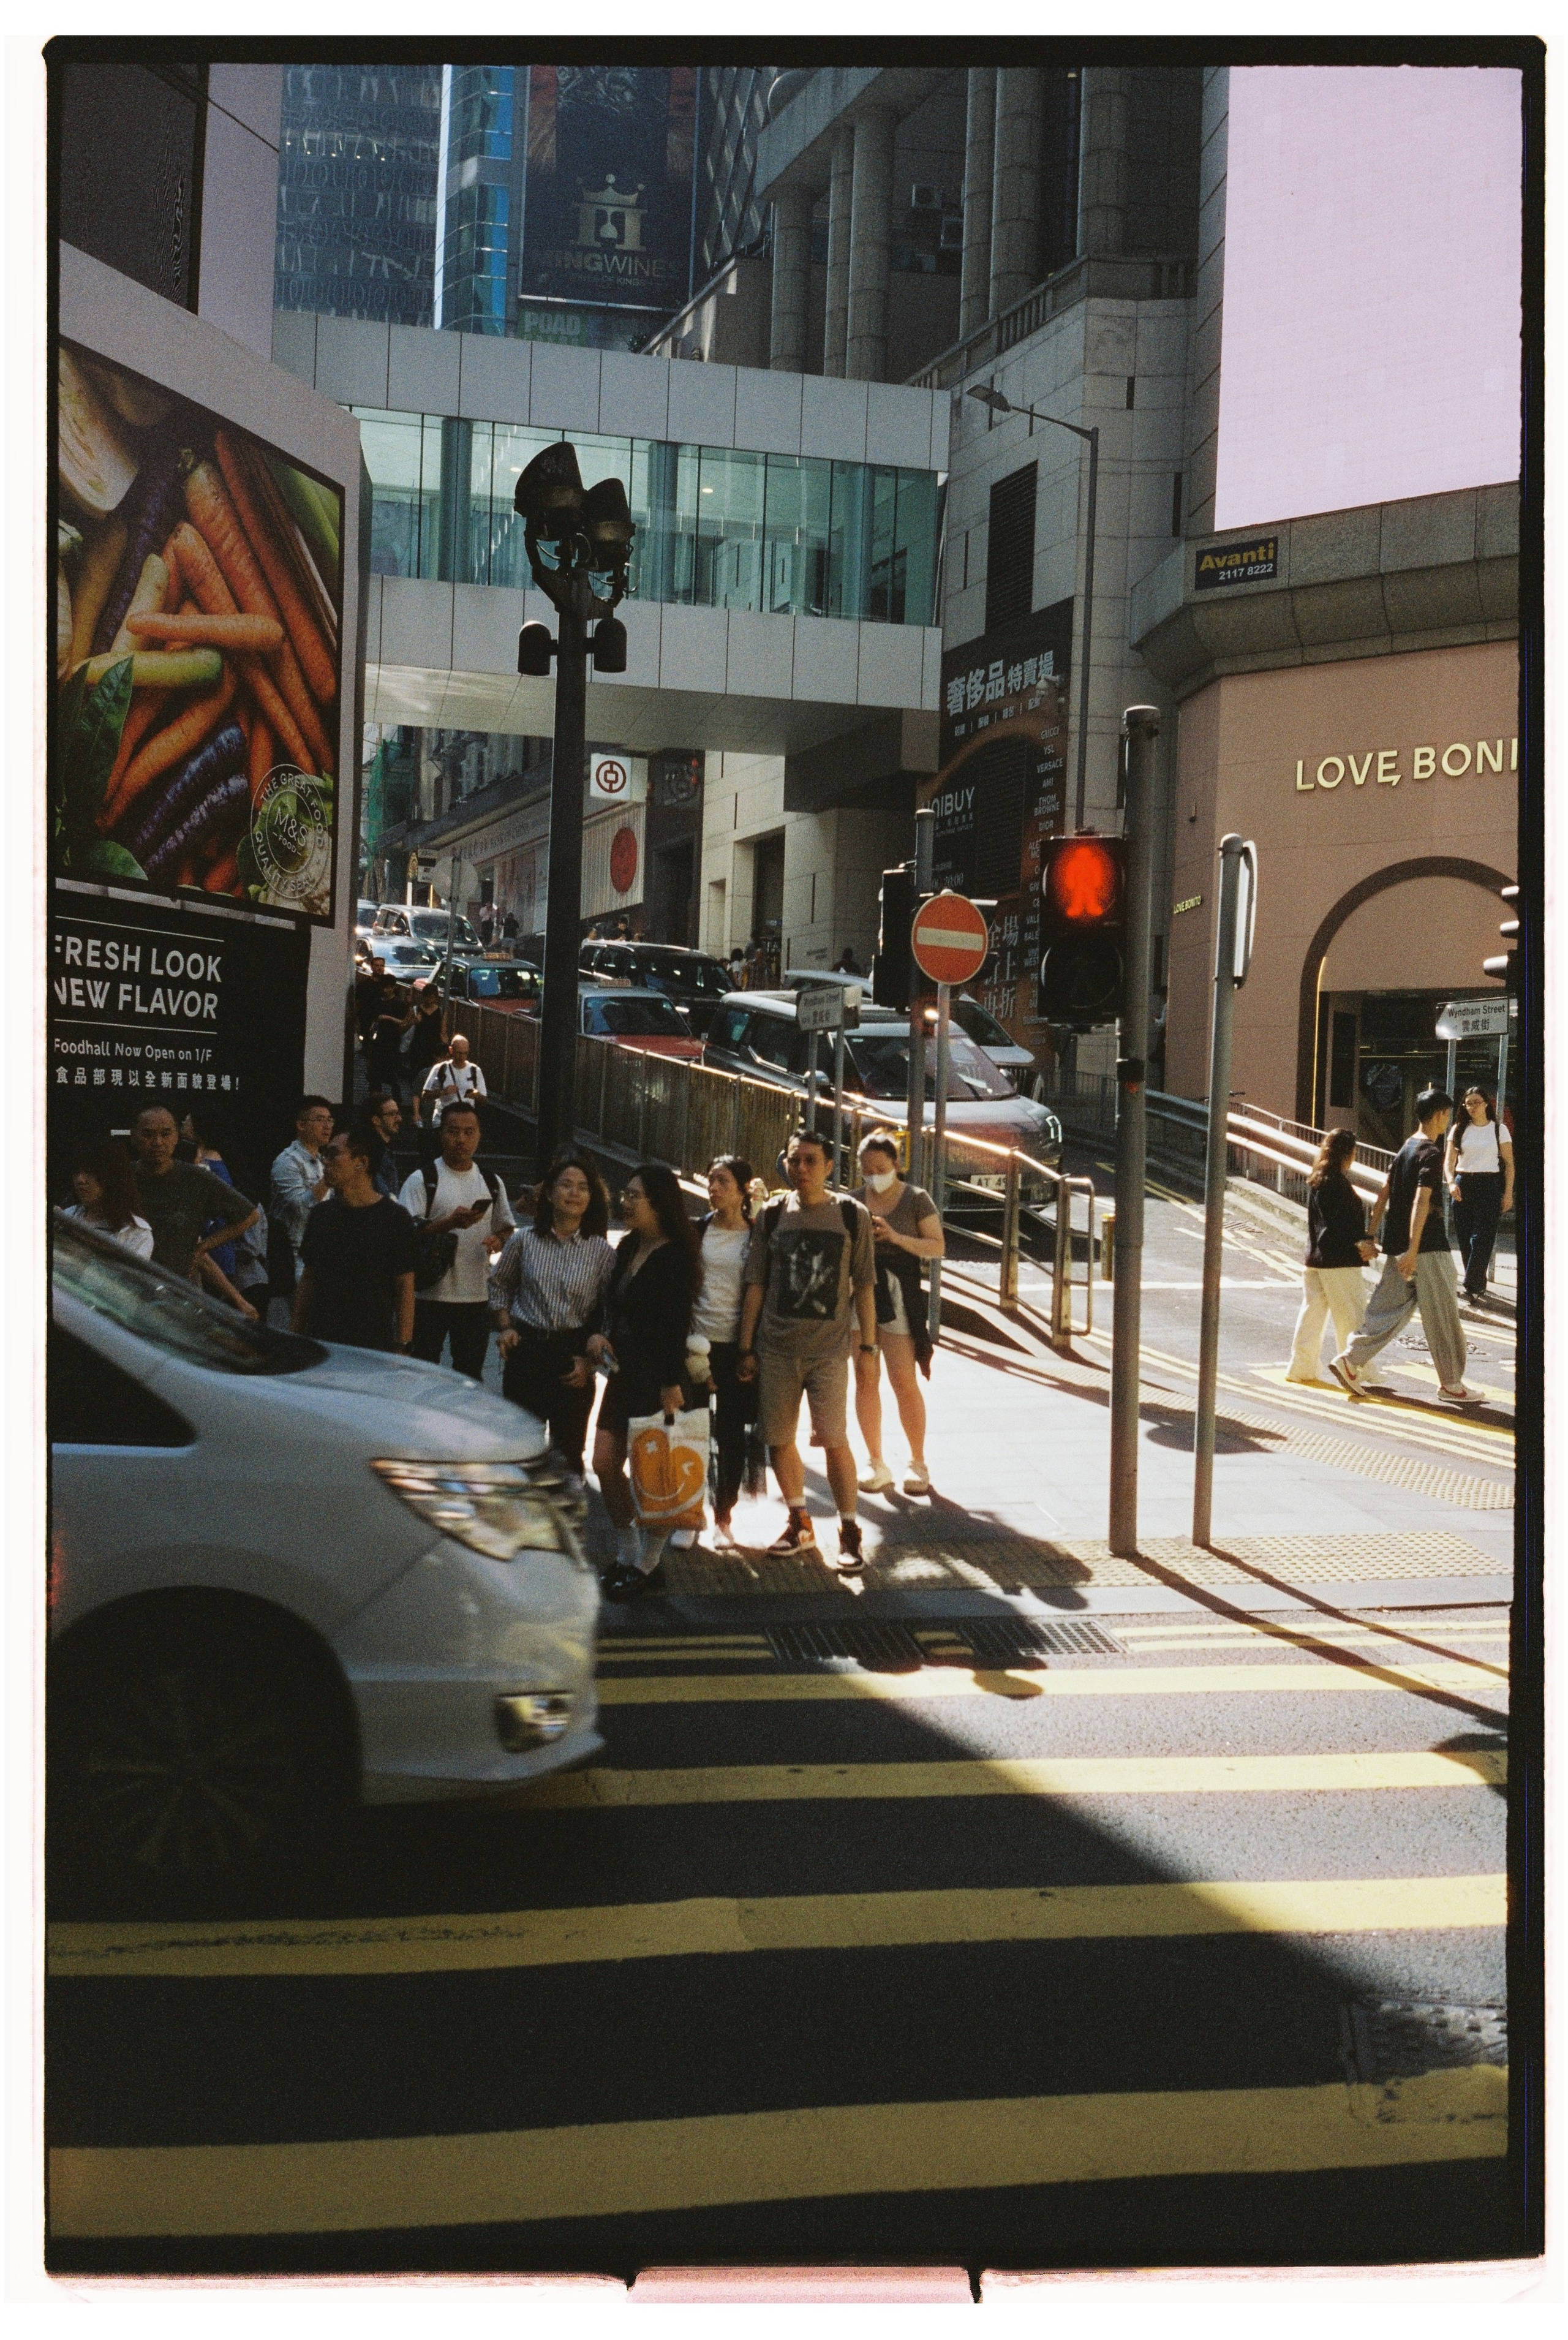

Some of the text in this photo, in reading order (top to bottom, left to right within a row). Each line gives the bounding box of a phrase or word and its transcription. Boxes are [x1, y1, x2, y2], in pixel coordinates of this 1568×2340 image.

[1199, 542, 1274, 571] Avanti
[1219, 563, 1273, 580] 2117 8222
[1041, 726, 1060, 739] GUCCI
[1043, 744, 1055, 755] YSL
[1037, 758, 1063, 773] VERSACE
[260, 777, 279, 801] THE
[280, 772, 312, 798] GREAT
[1039, 794, 1057, 807] THOM
[1034, 802, 1060, 817] BROWNE
[274, 806, 307, 847] M&S
[1039, 820, 1054, 832] DIOR
[279, 836, 297, 853] FOOD
[255, 831, 312, 891] QUALITY SEAL
[150, 948, 222, 983] LOOK
[118, 983, 219, 1019] FLAVOR
[1448, 1005, 1506, 1018] Wyndham Street
[54, 1038, 213, 1063] Foodhall Now Open on 1/F
[977, 1177, 990, 1187] AT
